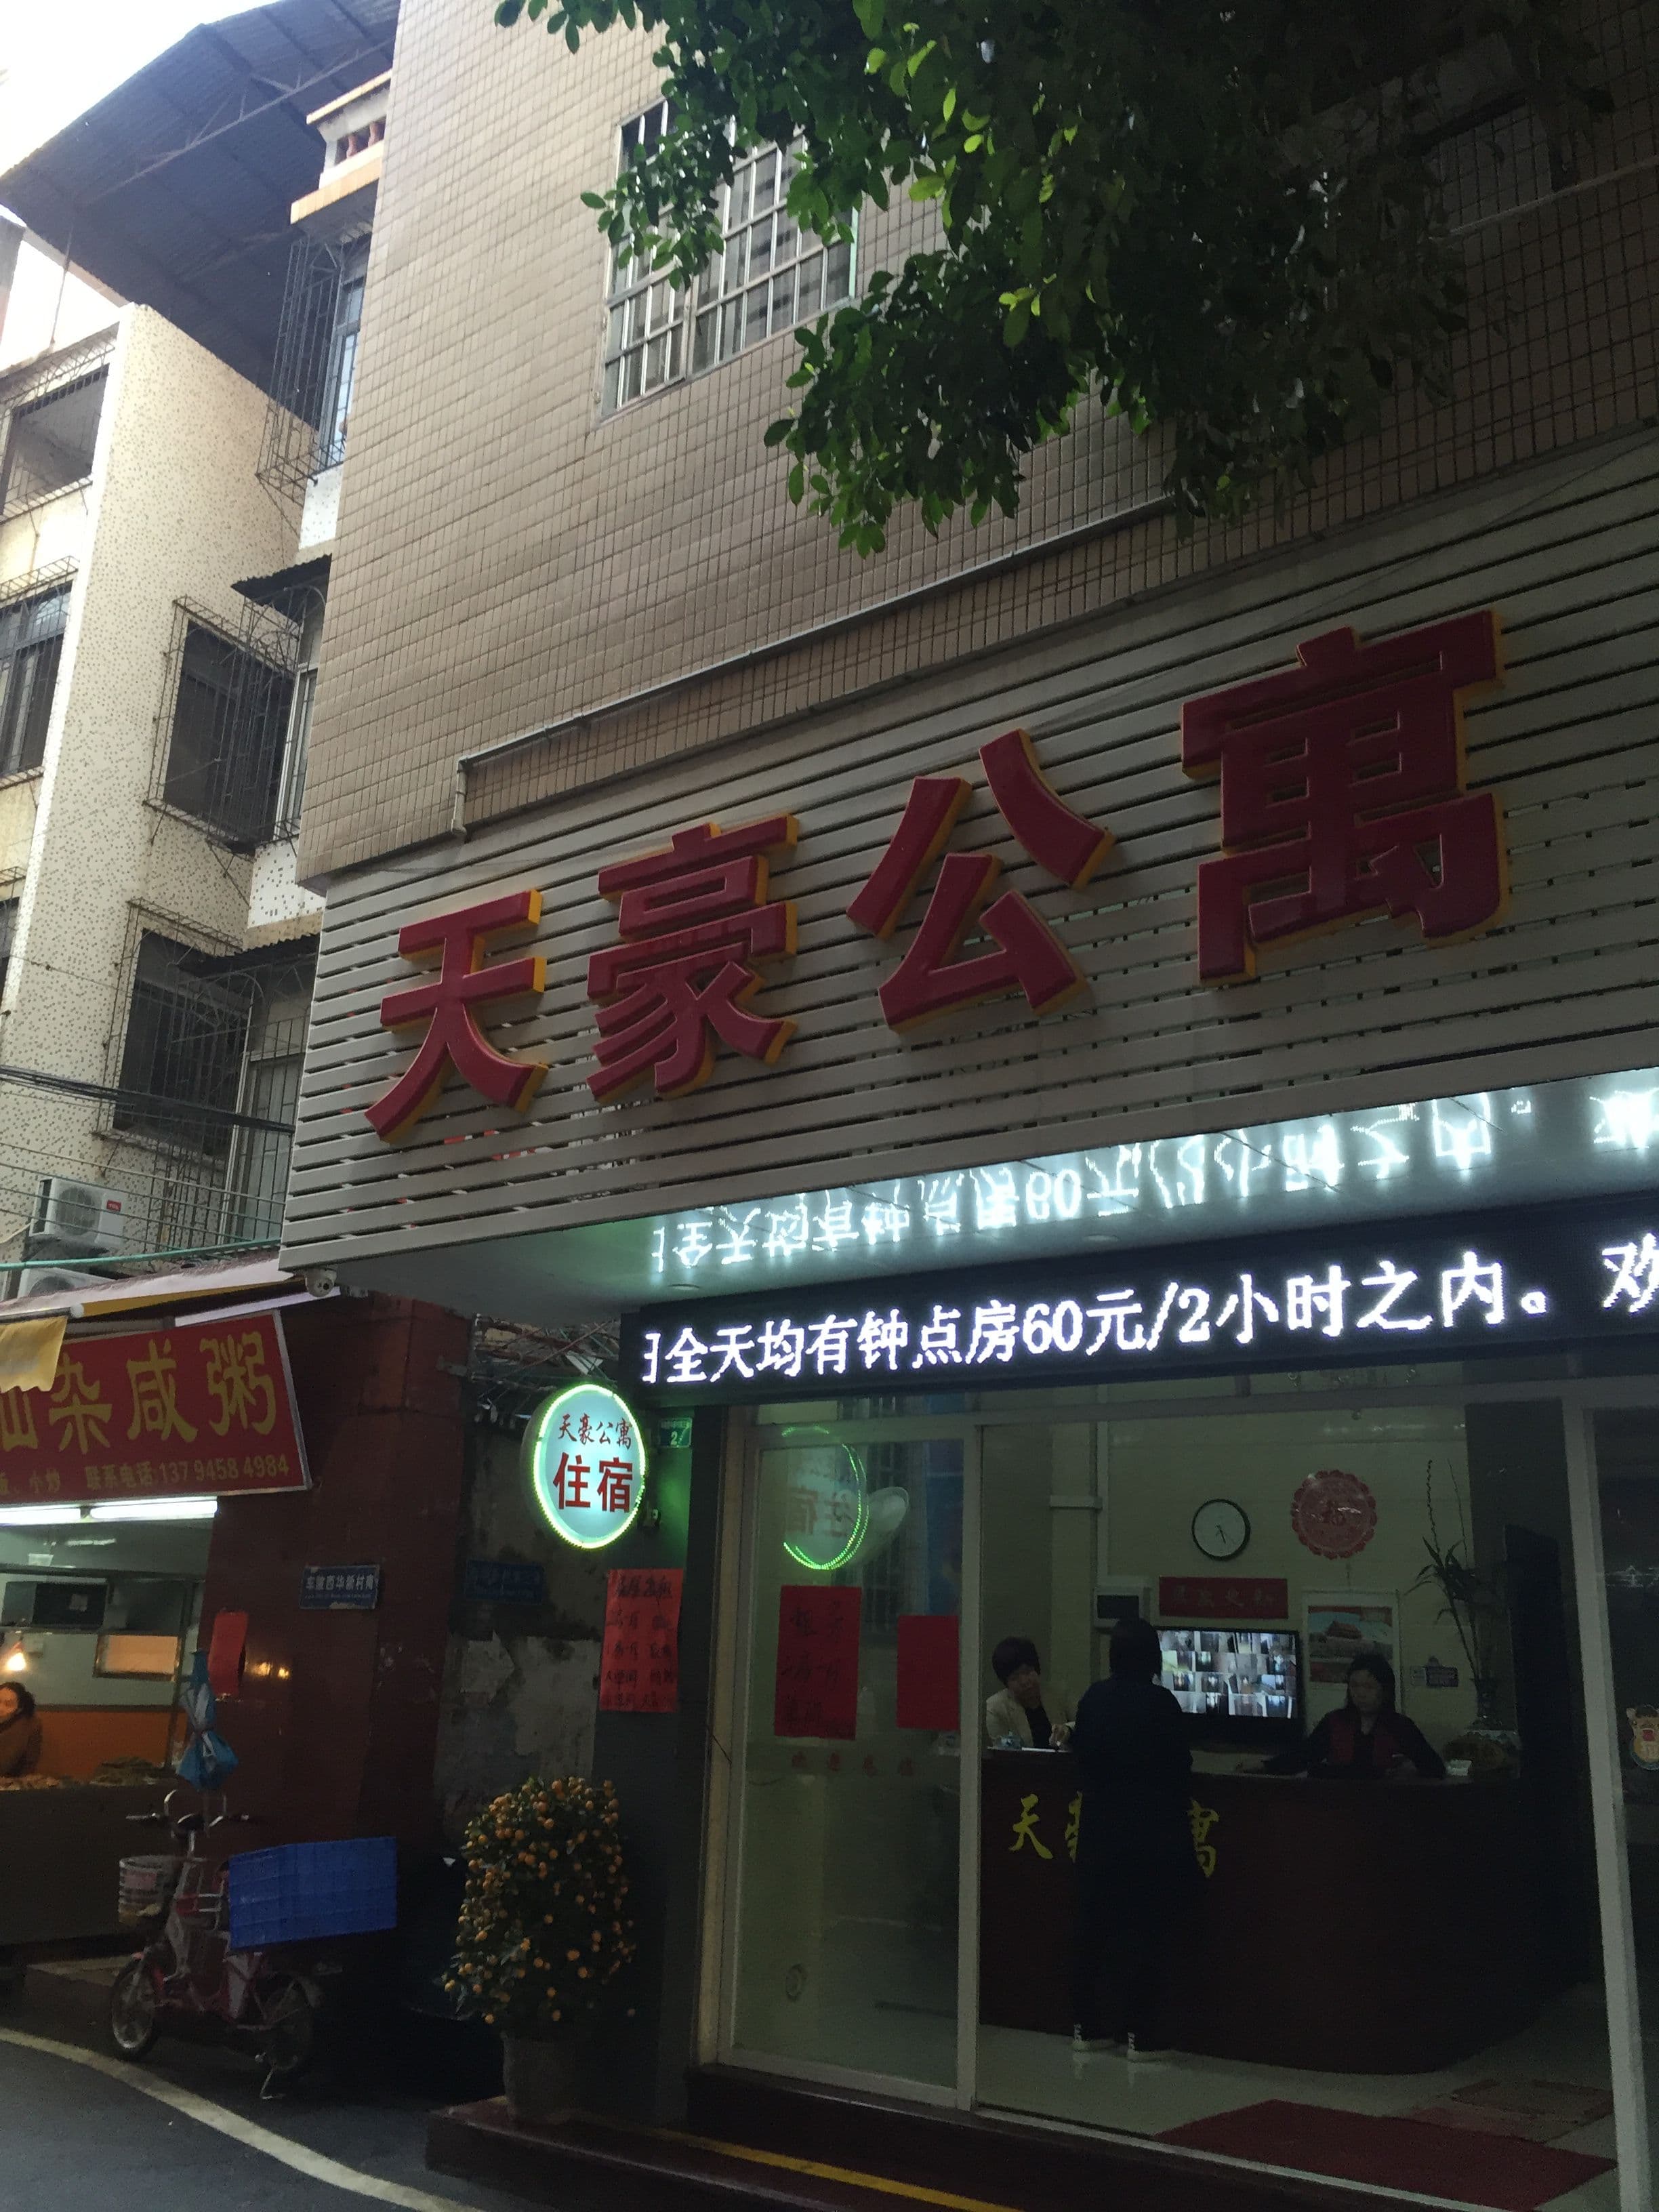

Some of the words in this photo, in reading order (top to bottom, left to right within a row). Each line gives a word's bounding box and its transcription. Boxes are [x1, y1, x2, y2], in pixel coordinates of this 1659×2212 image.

[364, 610, 1509, 1143] 天豪公寓
[558, 1413, 632, 1450] 天豪公寓
[243, 1454, 289, 1477] 4984
[552, 1452, 633, 1513] 住宿
